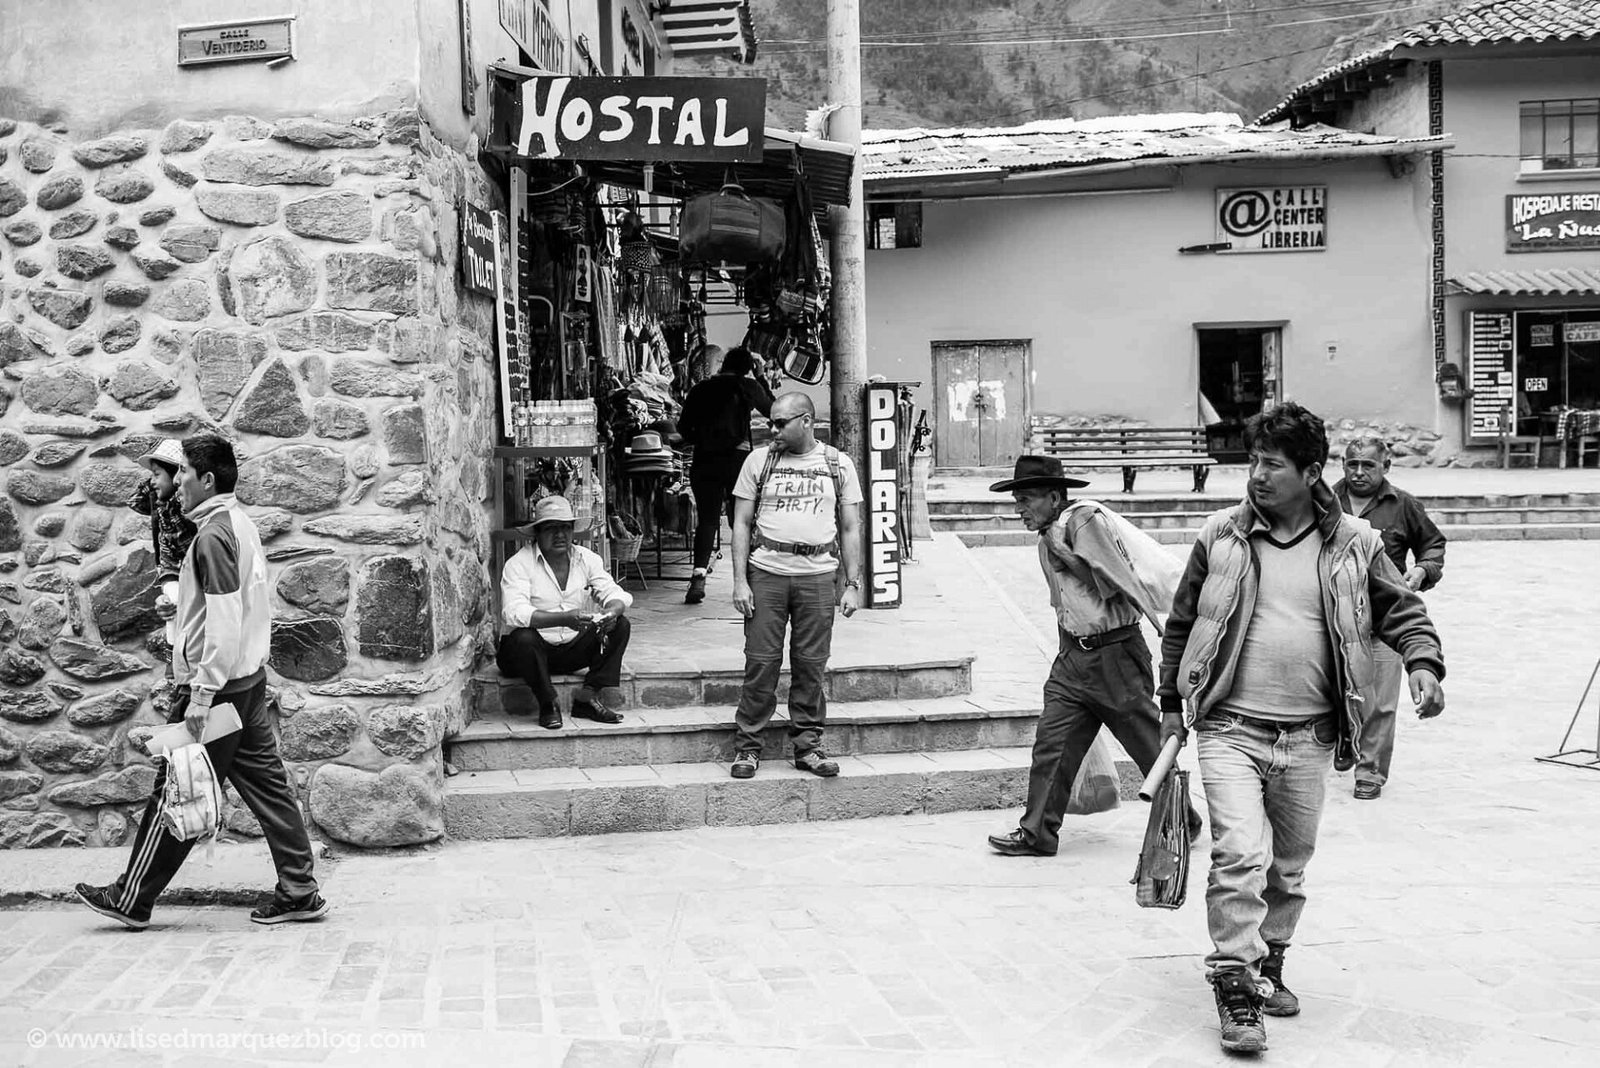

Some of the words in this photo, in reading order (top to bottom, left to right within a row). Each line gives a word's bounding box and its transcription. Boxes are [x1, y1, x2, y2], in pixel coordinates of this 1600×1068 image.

[219, 29, 249, 39] CALLE
[517, 77, 749, 159] HOSTAL
[1273, 188, 1320, 206] CALL
[1274, 207, 1324, 225] CENTER
[1512, 196, 1571, 225] HOSPEDAJE
[1572, 194, 1600, 211] REST
[1262, 230, 1324, 248] LIBRERIA
[1526, 379, 1547, 391] OPEN
[774, 480, 824, 497] TRAIN
[869, 388, 900, 604] DOLARES
